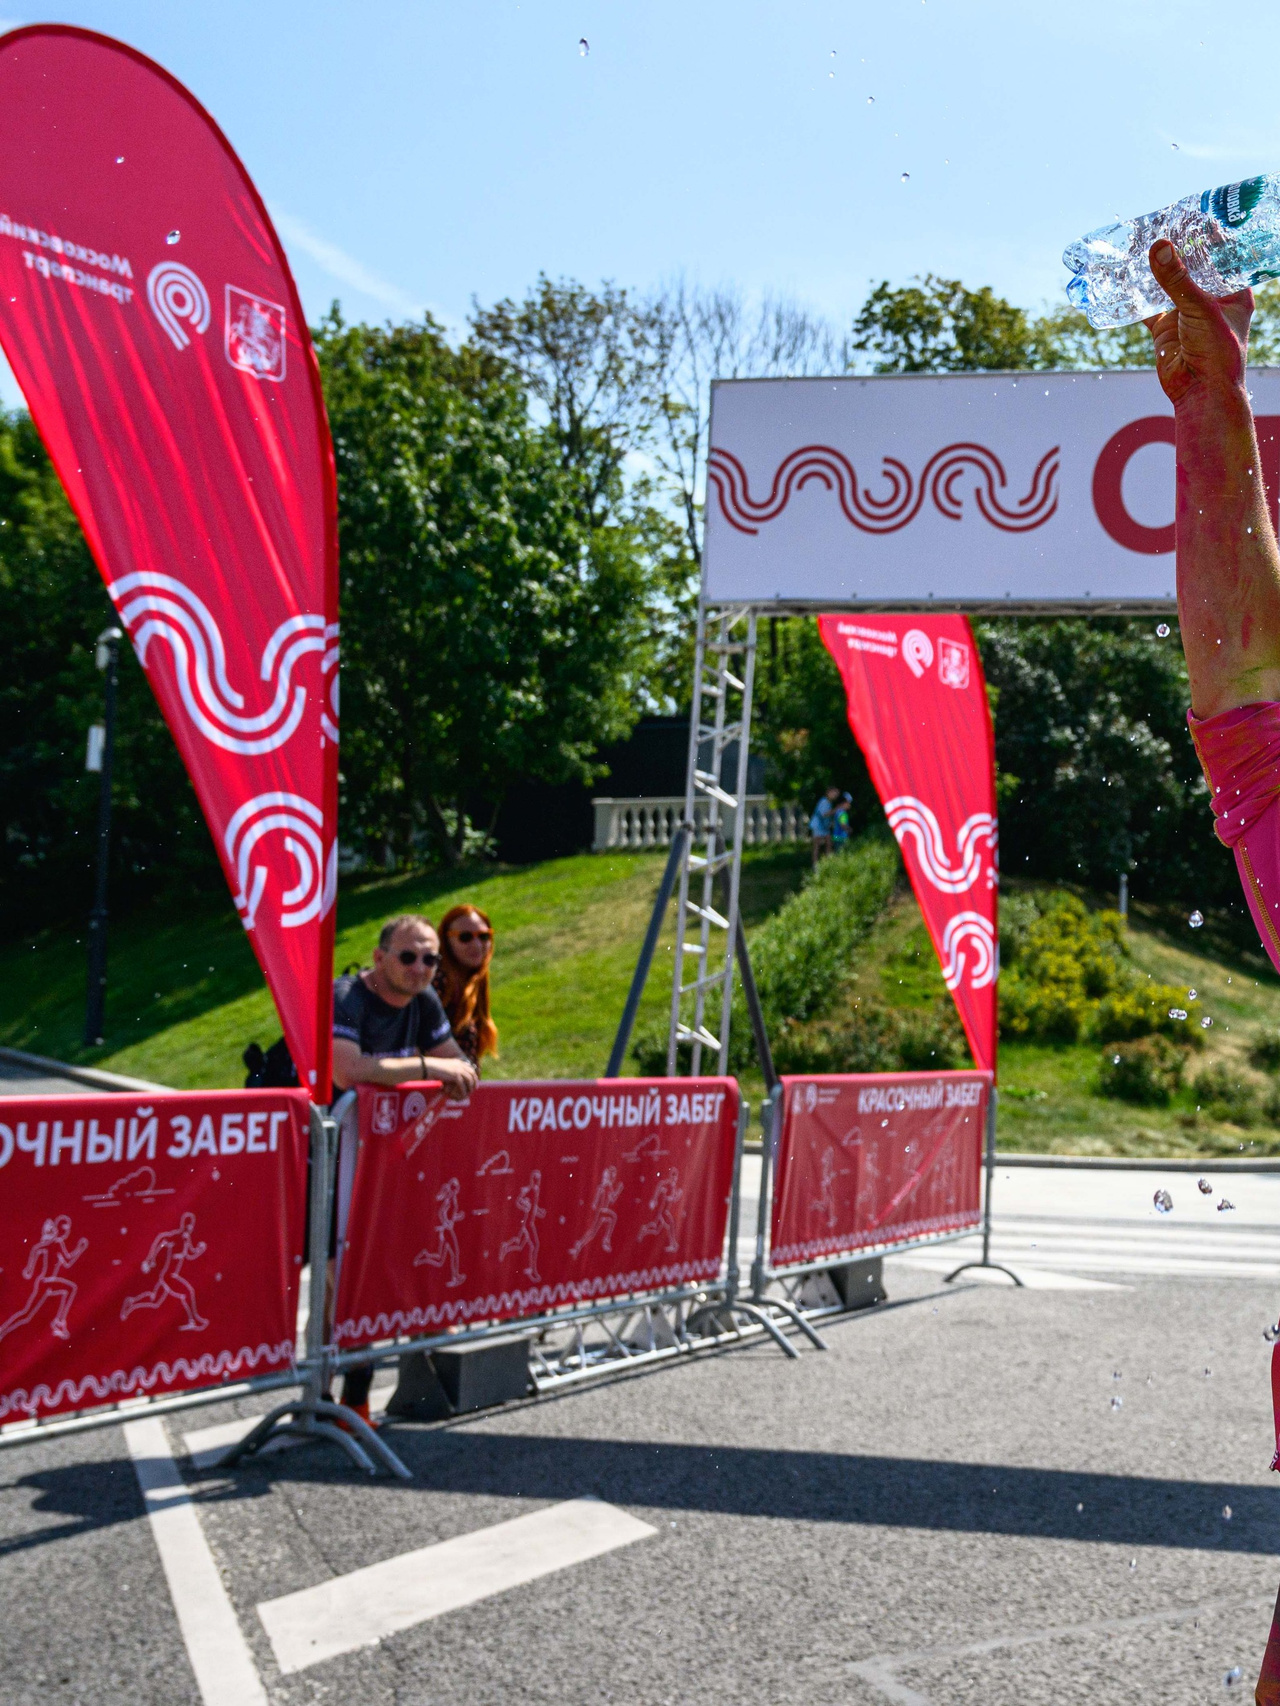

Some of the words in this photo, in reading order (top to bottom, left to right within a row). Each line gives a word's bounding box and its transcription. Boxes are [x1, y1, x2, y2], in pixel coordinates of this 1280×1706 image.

[508, 1087, 661, 1133] КРАСОЧНЫЙ
[664, 1093, 725, 1126] ЗАБЕГ
[167, 1110, 289, 1159] ЗАБЕГ
